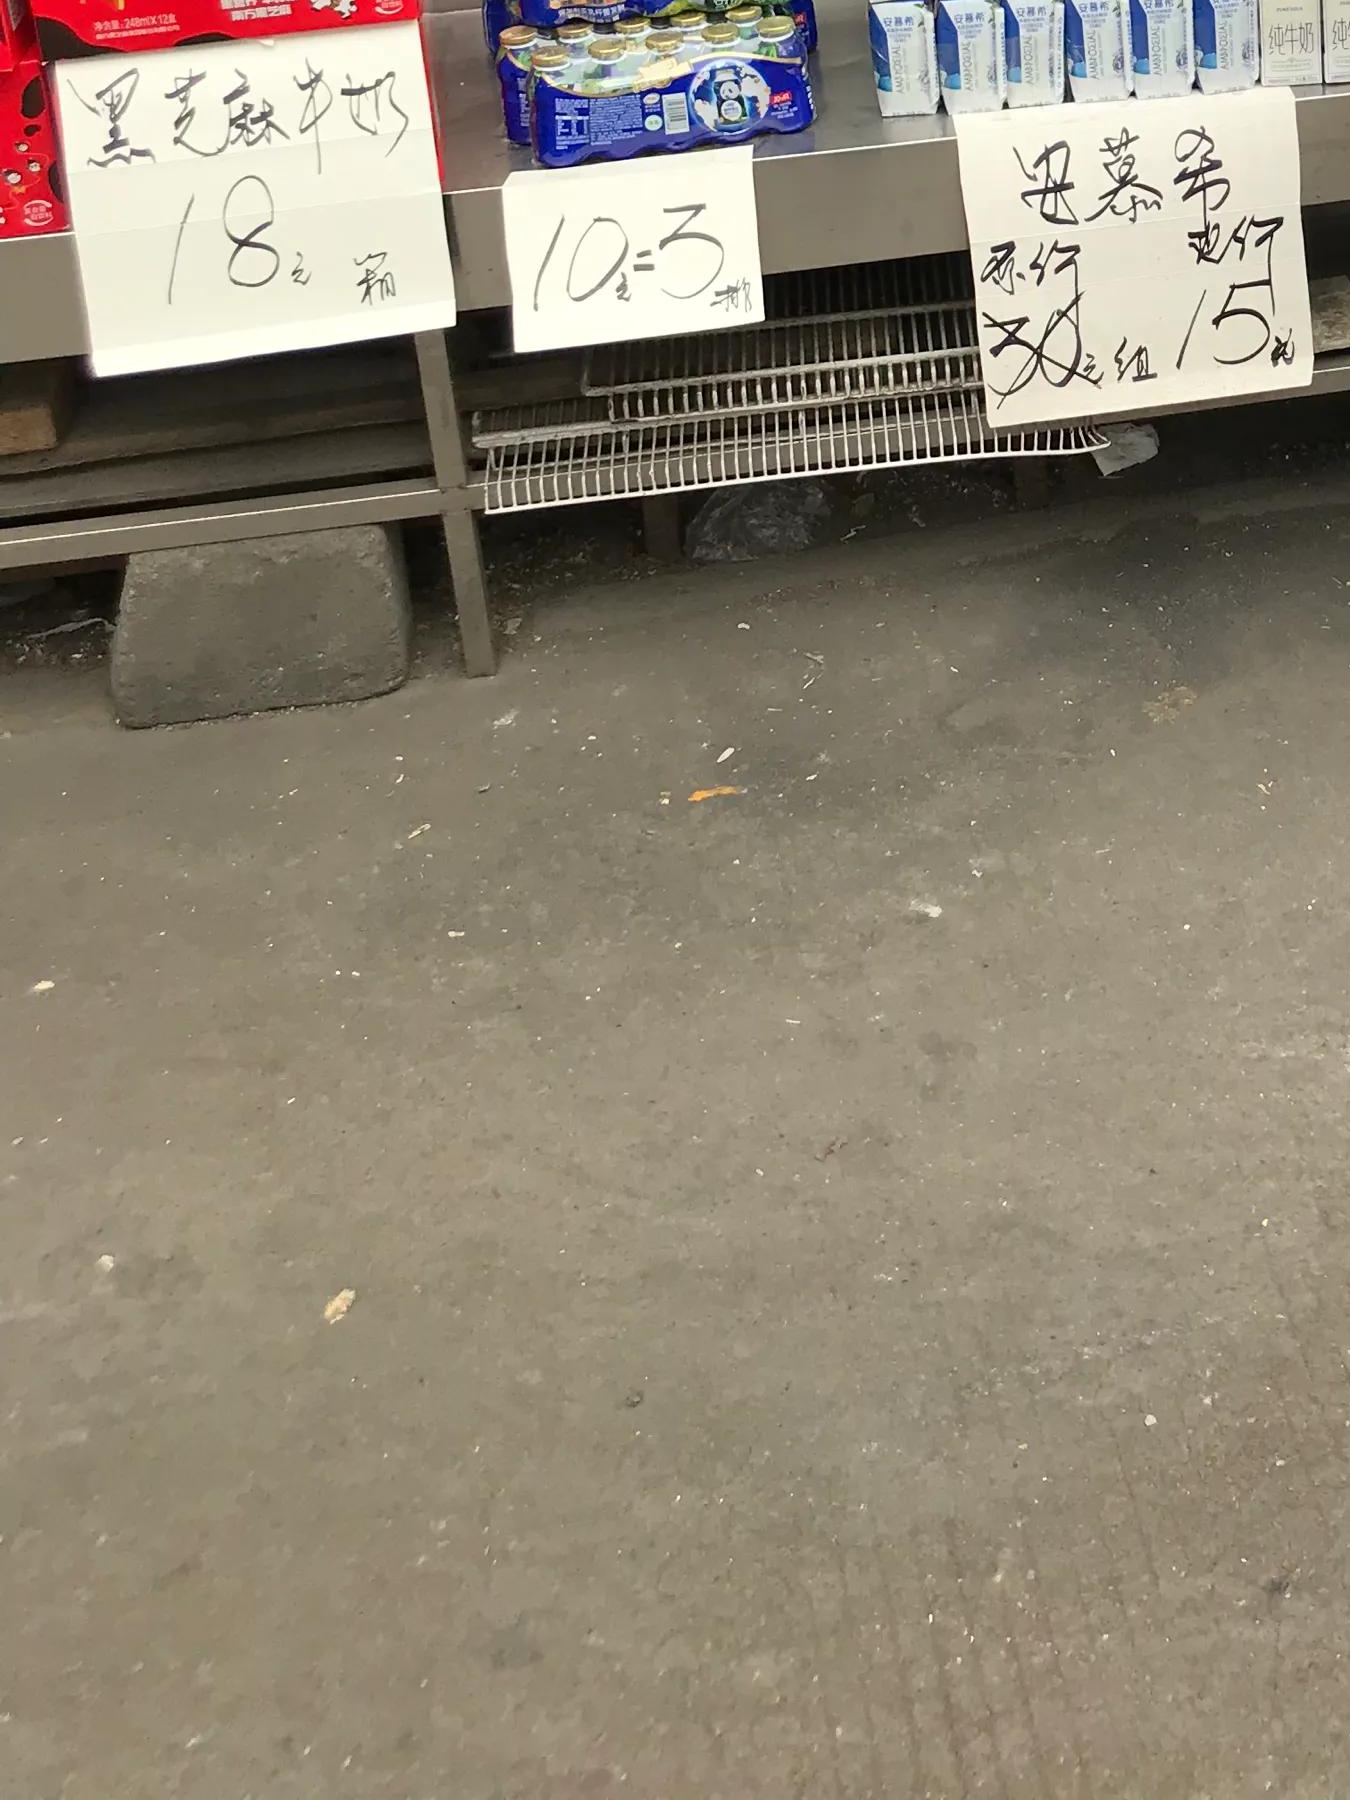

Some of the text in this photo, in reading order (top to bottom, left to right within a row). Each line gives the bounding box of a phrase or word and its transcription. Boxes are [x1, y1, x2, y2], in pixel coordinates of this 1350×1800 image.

[1015, 4, 1047, 19] 安慕希
[1079, 0, 1110, 14] 安慕希
[882, 14, 914, 28] 安慕希
[953, 12, 985, 26] 安慕希
[1268, 22, 1314, 56] 纯牛奶
[67, 57, 410, 175] 黑芝麻牛奶
